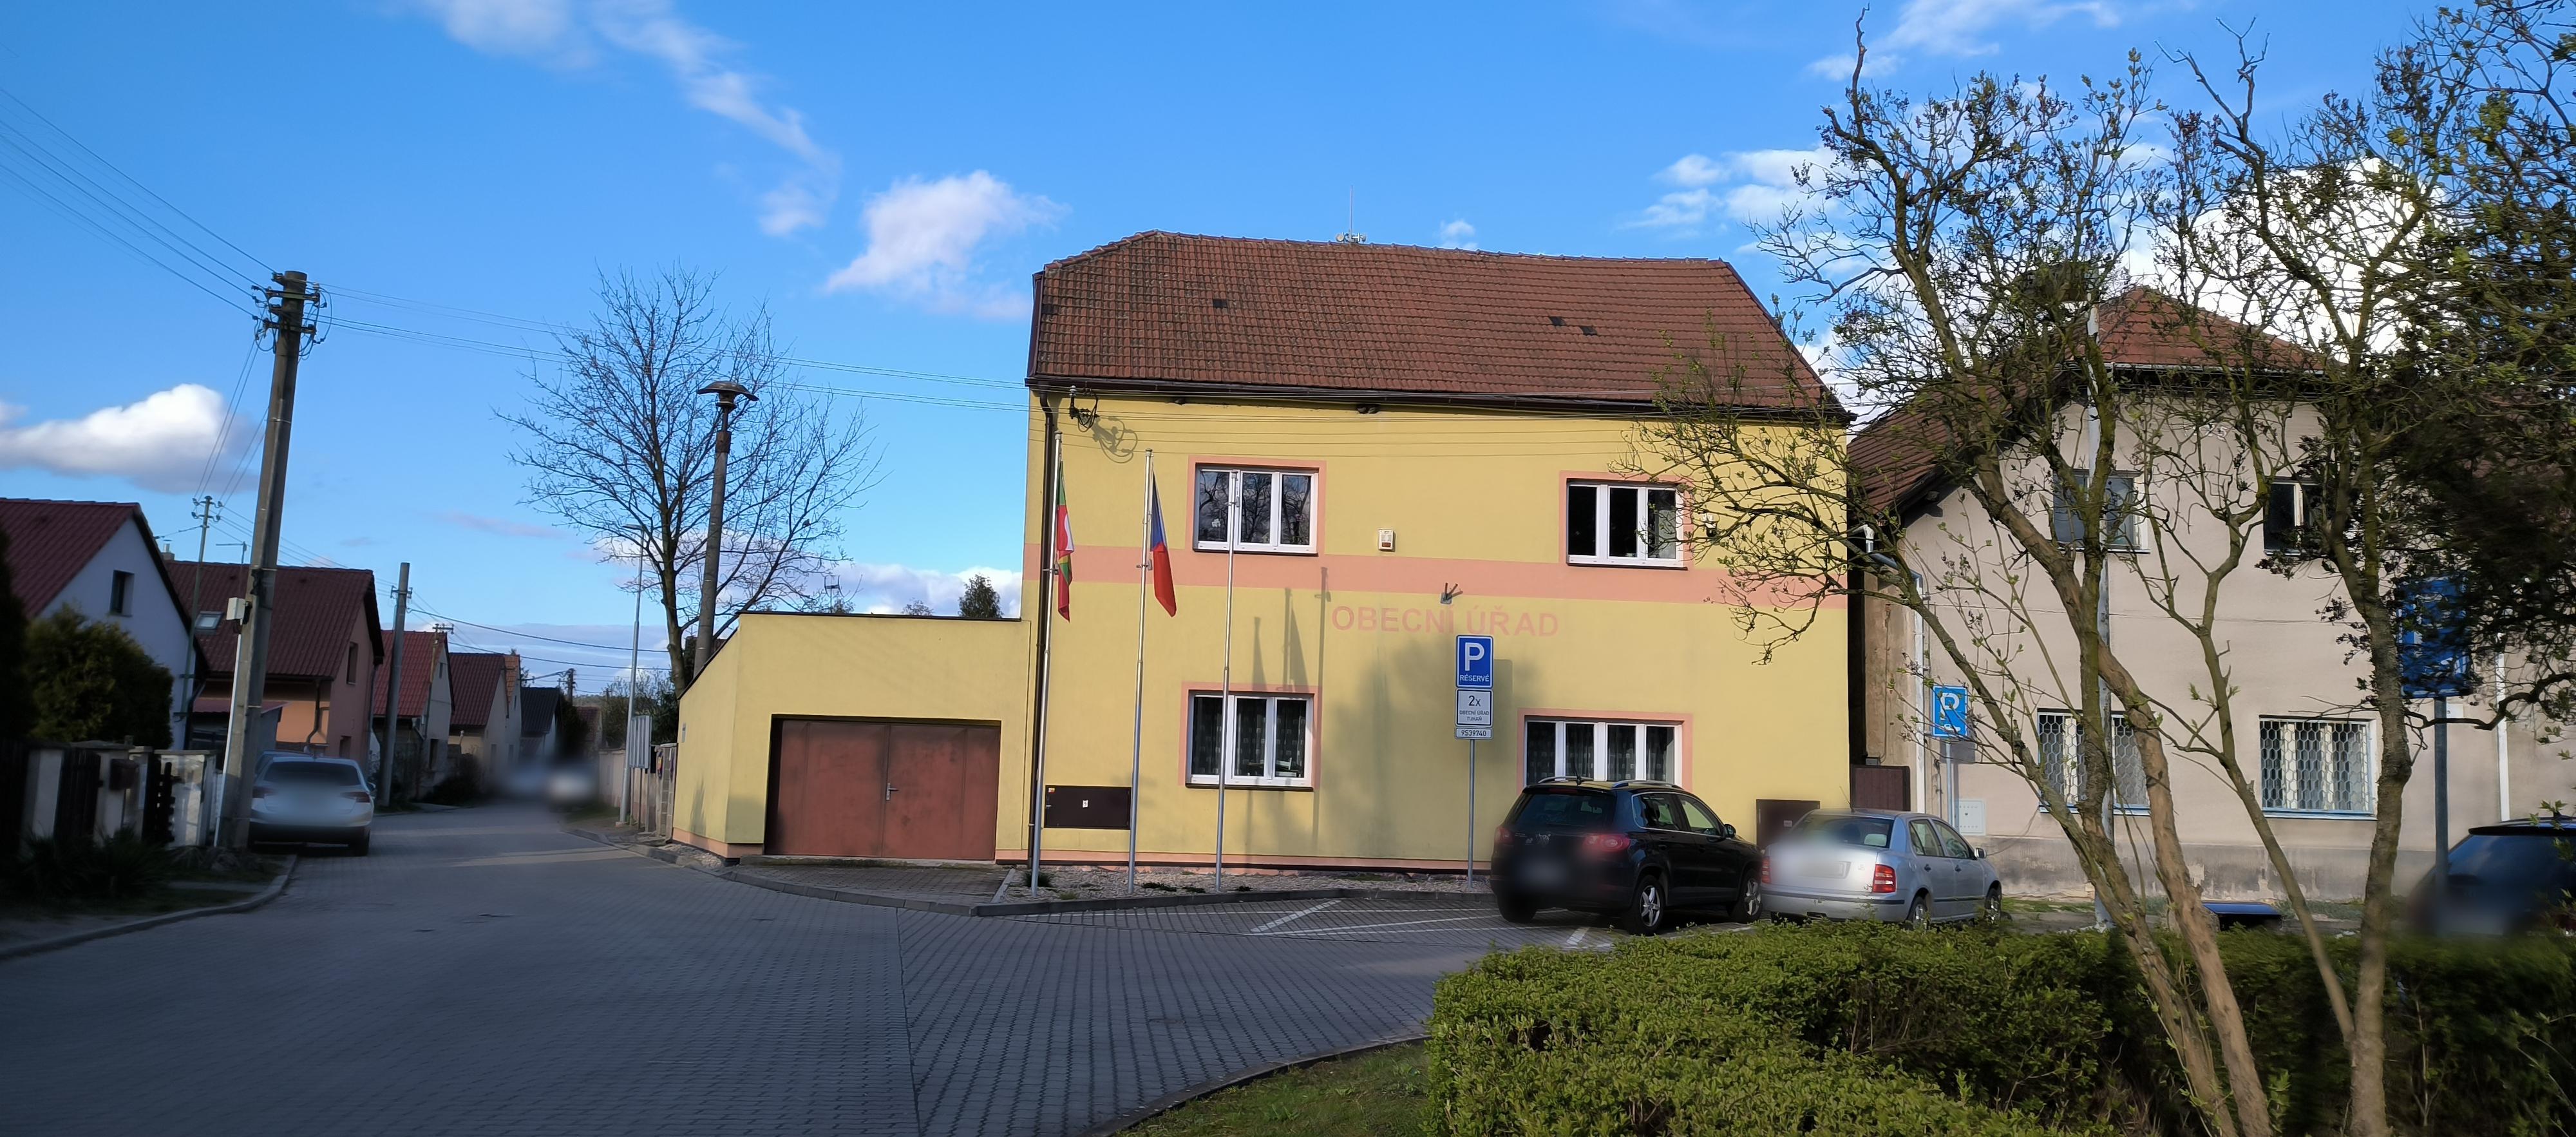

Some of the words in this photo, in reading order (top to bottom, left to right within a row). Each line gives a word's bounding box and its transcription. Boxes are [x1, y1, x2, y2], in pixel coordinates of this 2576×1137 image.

[1331, 604, 1455, 634] OBECNÍ
[1466, 604, 1559, 637] ÚŘAD
[1464, 642, 1484, 671] P
[1459, 673, 1490, 682] RÉSERVÉ
[1468, 695, 1481, 707] 2x
